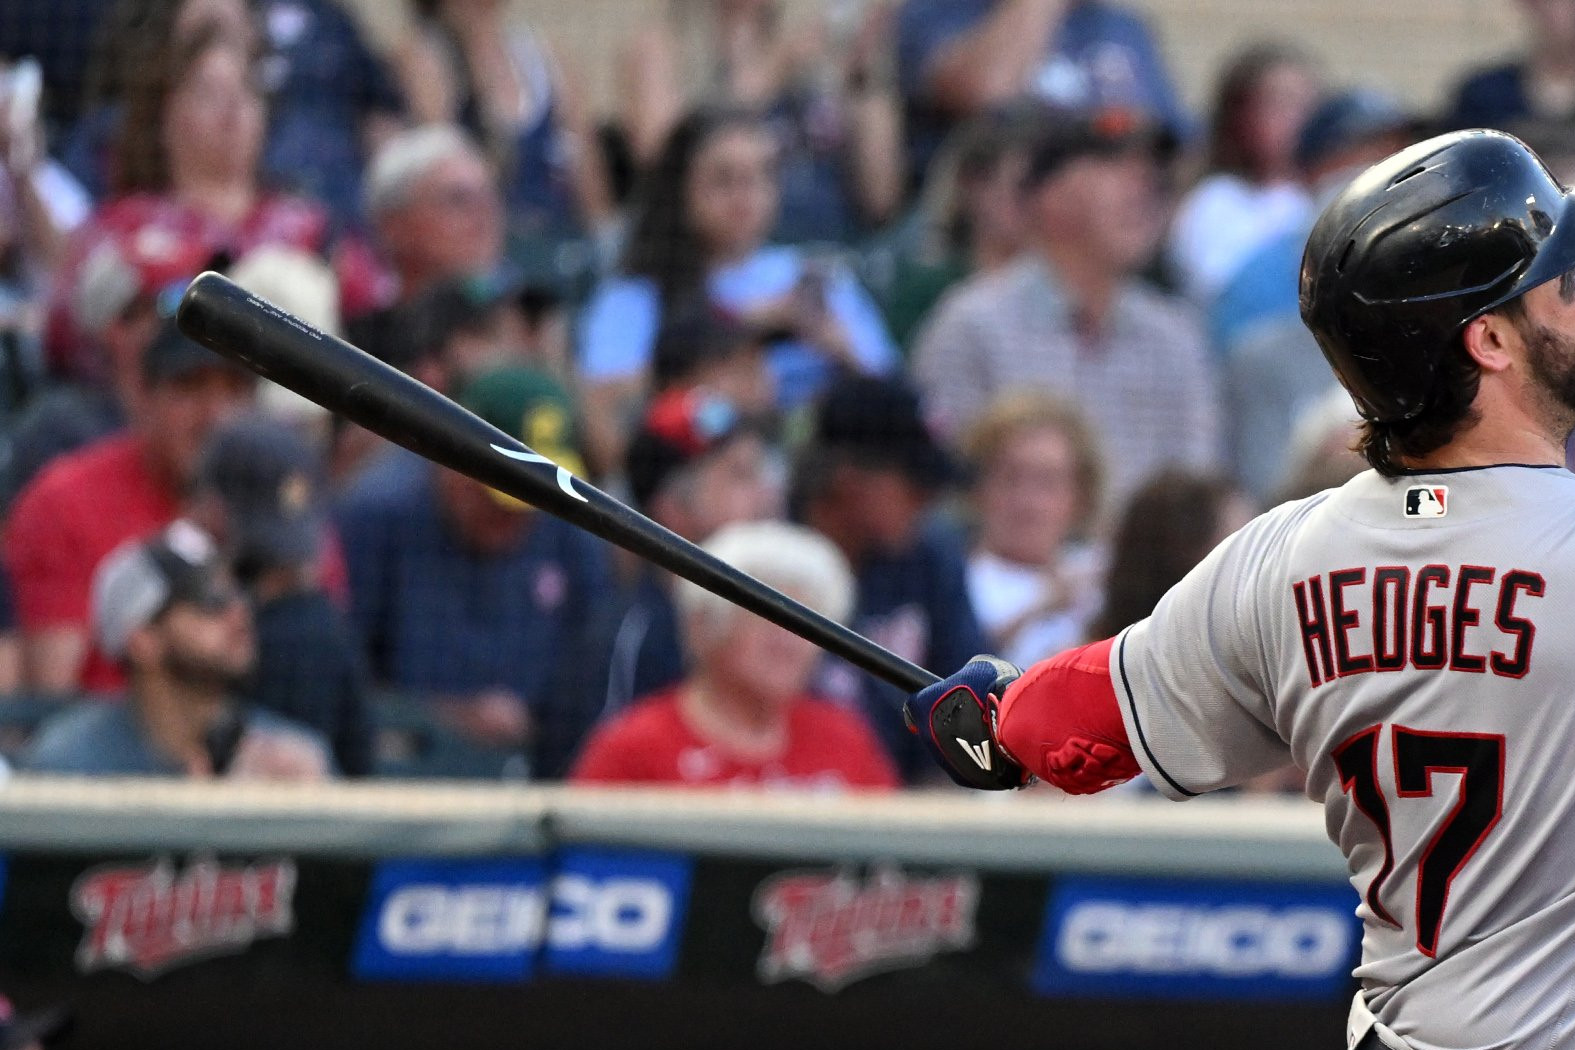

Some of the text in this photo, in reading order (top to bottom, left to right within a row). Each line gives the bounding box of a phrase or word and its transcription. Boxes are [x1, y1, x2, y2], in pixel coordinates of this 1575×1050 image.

[1293, 564, 1546, 688] HEDGES
[1332, 723, 1506, 958] 17
[379, 876, 675, 955] GEICO
[1057, 901, 1349, 978] GEICO
